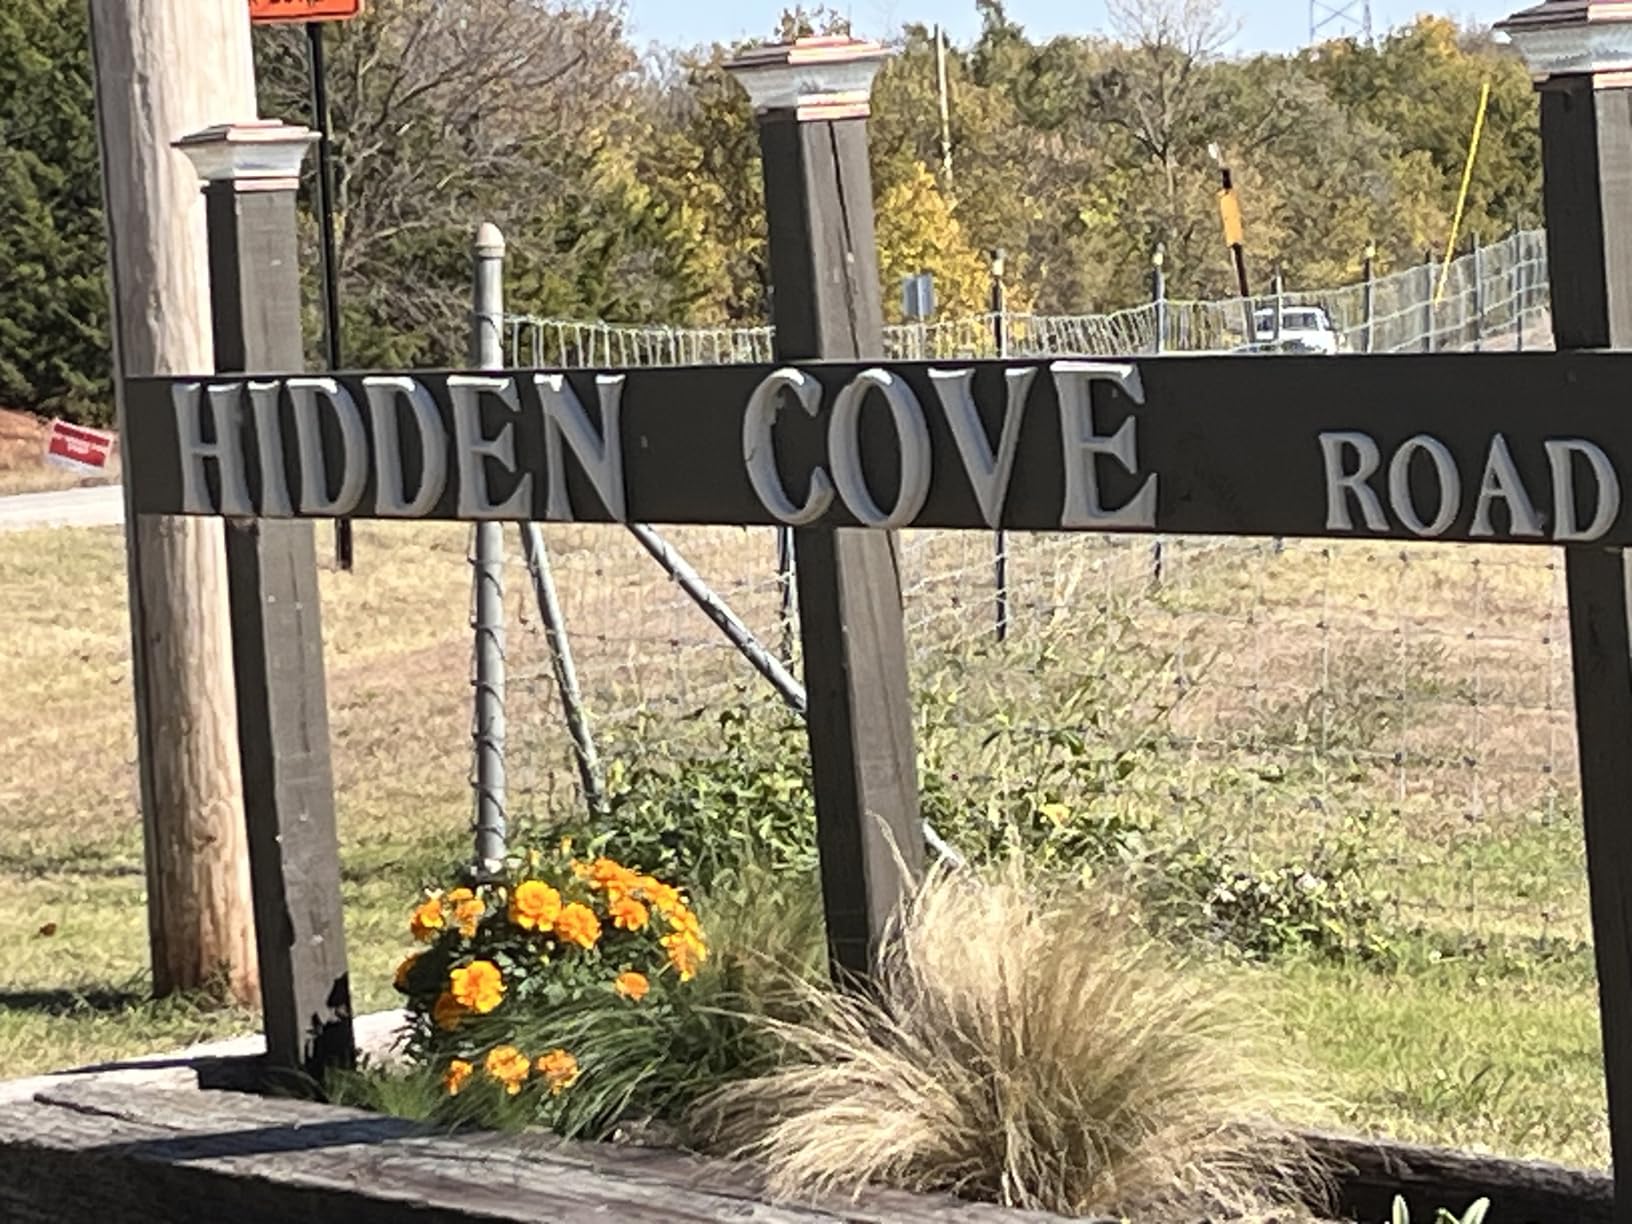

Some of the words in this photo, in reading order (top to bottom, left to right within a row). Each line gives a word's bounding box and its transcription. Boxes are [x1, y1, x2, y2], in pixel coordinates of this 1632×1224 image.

[171, 373, 626, 523] HIDDEN
[742, 361, 1158, 529] COVE
[1318, 432, 1620, 541] ROAD
